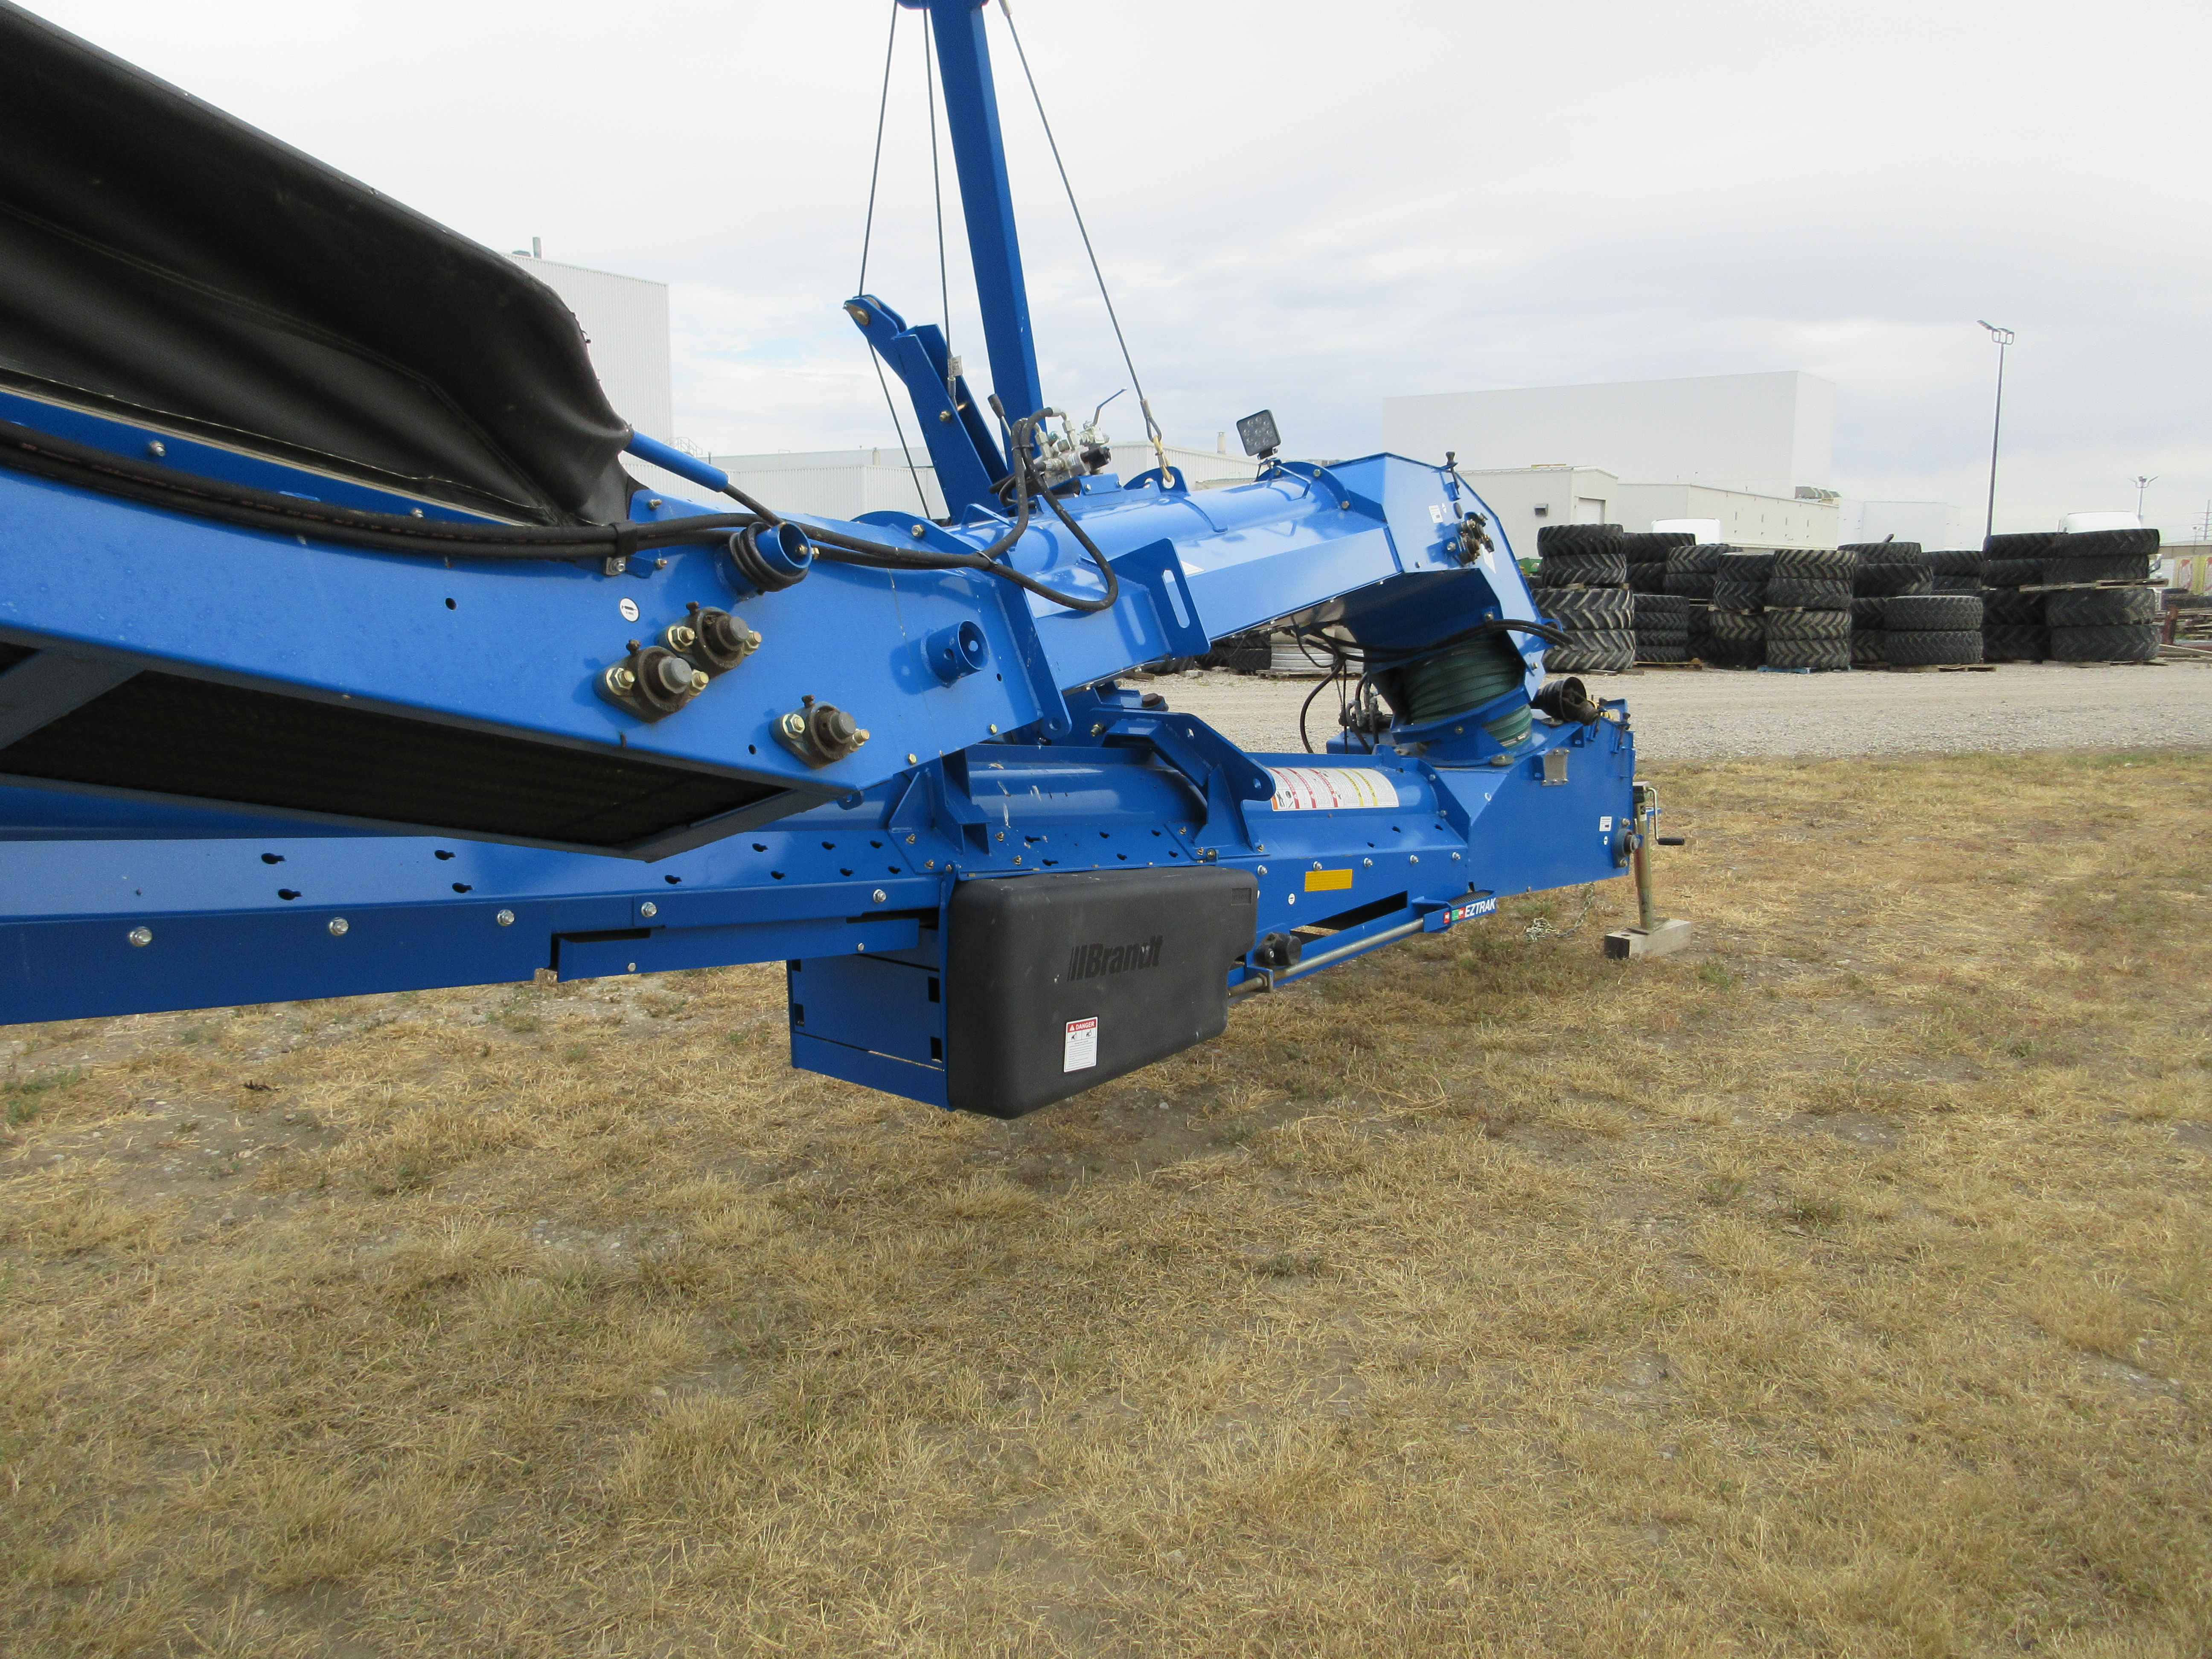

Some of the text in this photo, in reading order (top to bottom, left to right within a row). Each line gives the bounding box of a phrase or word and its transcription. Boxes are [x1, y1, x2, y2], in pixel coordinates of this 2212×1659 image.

[1279, 773, 1295, 792] DANGER
[1296, 773, 1312, 792] DANGER
[1318, 773, 1333, 792] DANGER
[1464, 897, 1496, 918] EZTRAK
[1084, 935, 1163, 978] Brandt
[1075, 1021, 1094, 1030] DANGER
